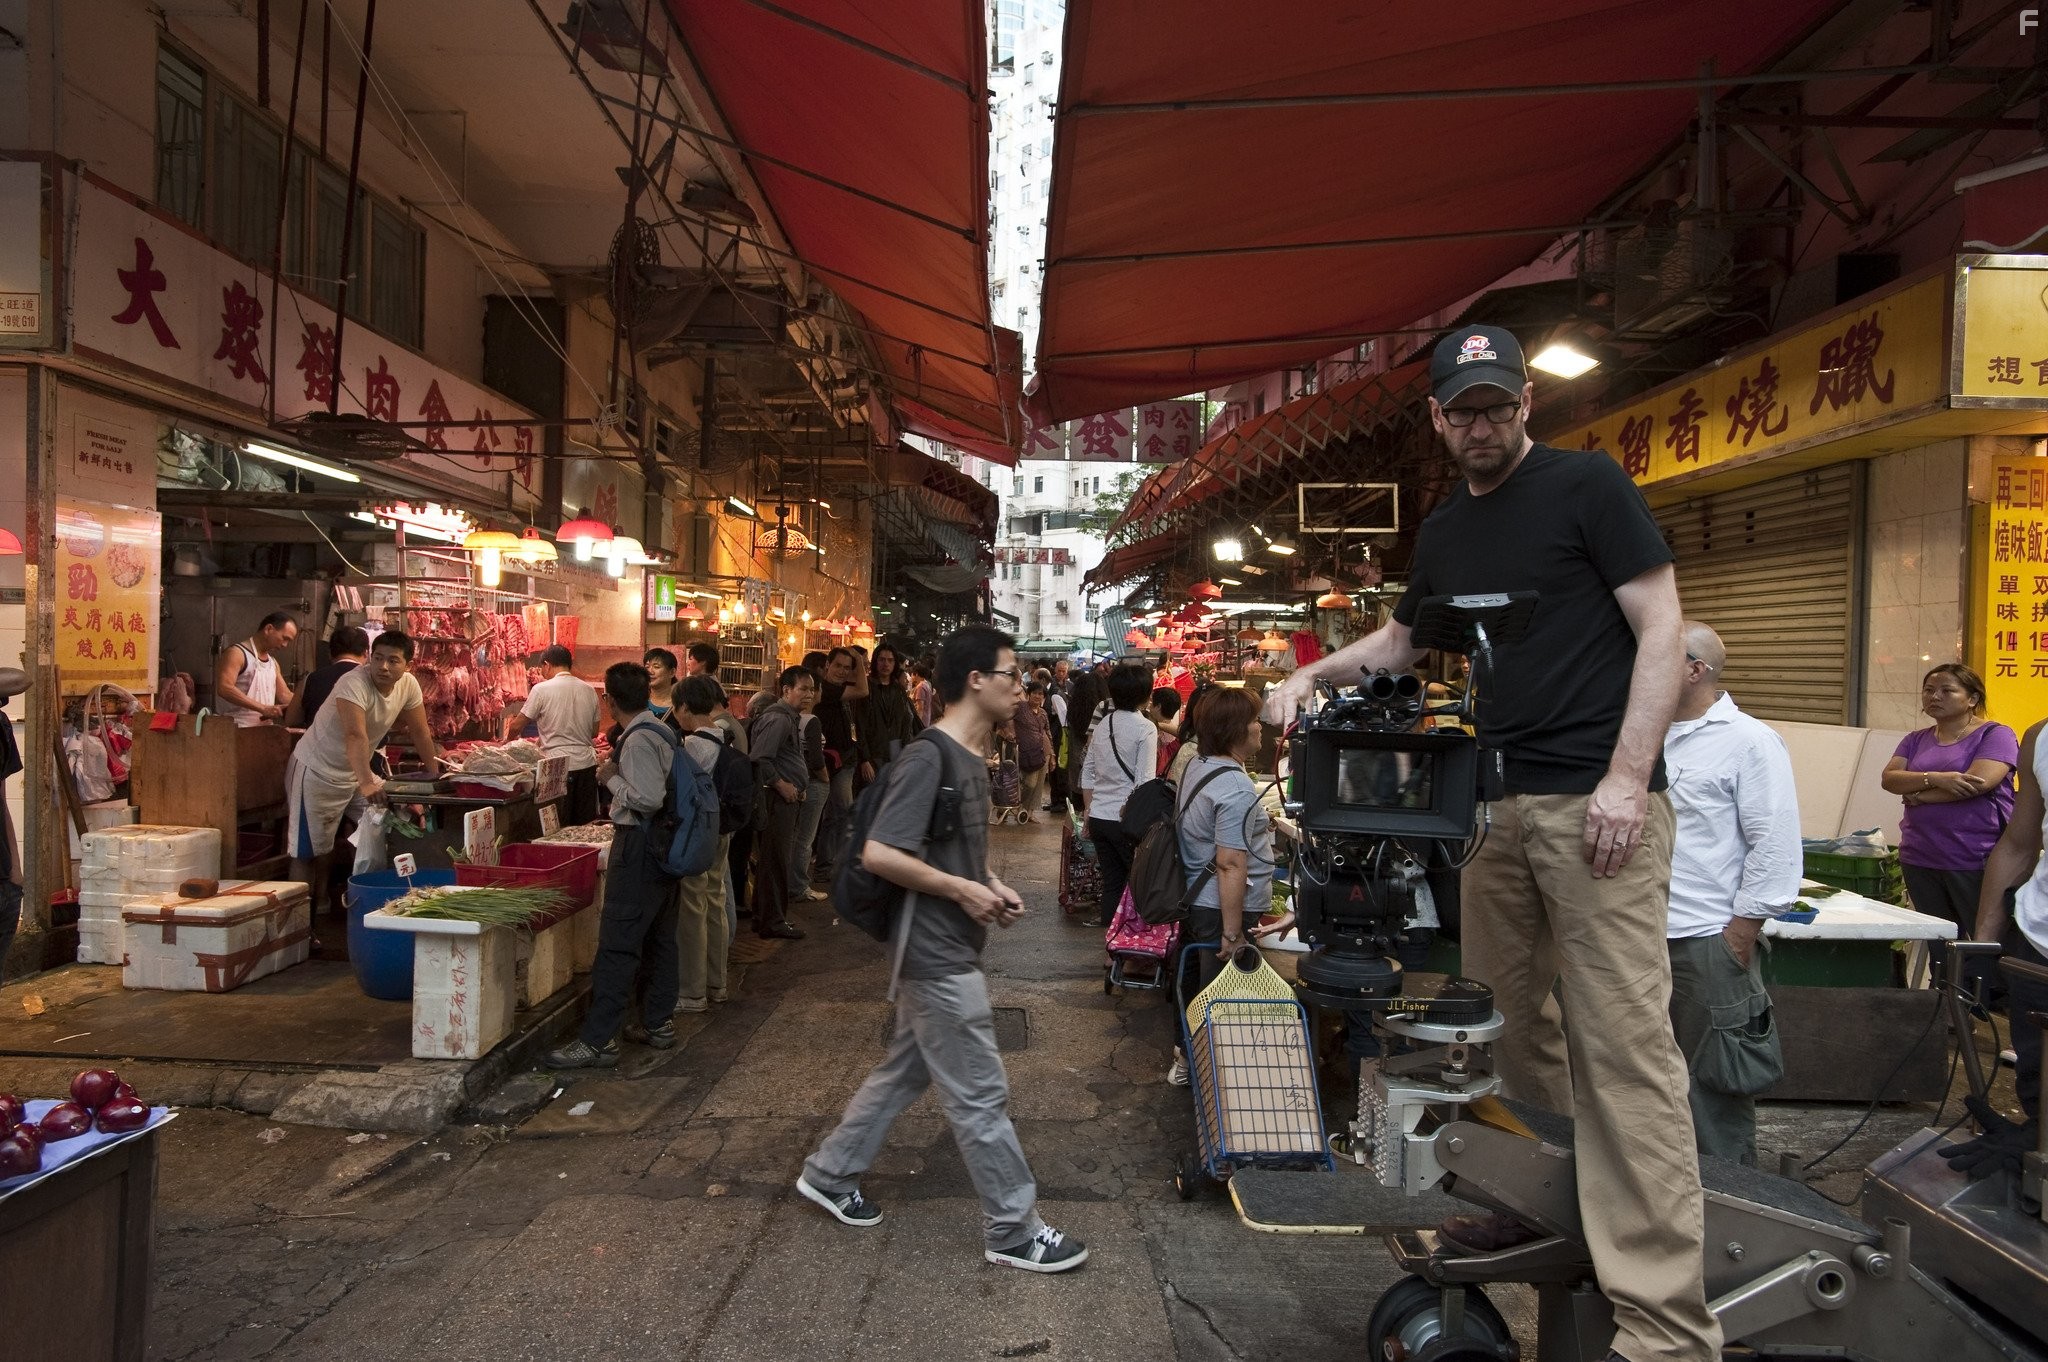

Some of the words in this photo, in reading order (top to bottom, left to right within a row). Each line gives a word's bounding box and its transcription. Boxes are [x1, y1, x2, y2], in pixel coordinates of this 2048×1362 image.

[1997, 466, 2048, 511] 再三回
[1995, 520, 2048, 563] 燒味飯
[62, 606, 146, 633] 爽滑順德
[76, 638, 136, 661] 鯪魚肉
[1350, 887, 1365, 901] A
